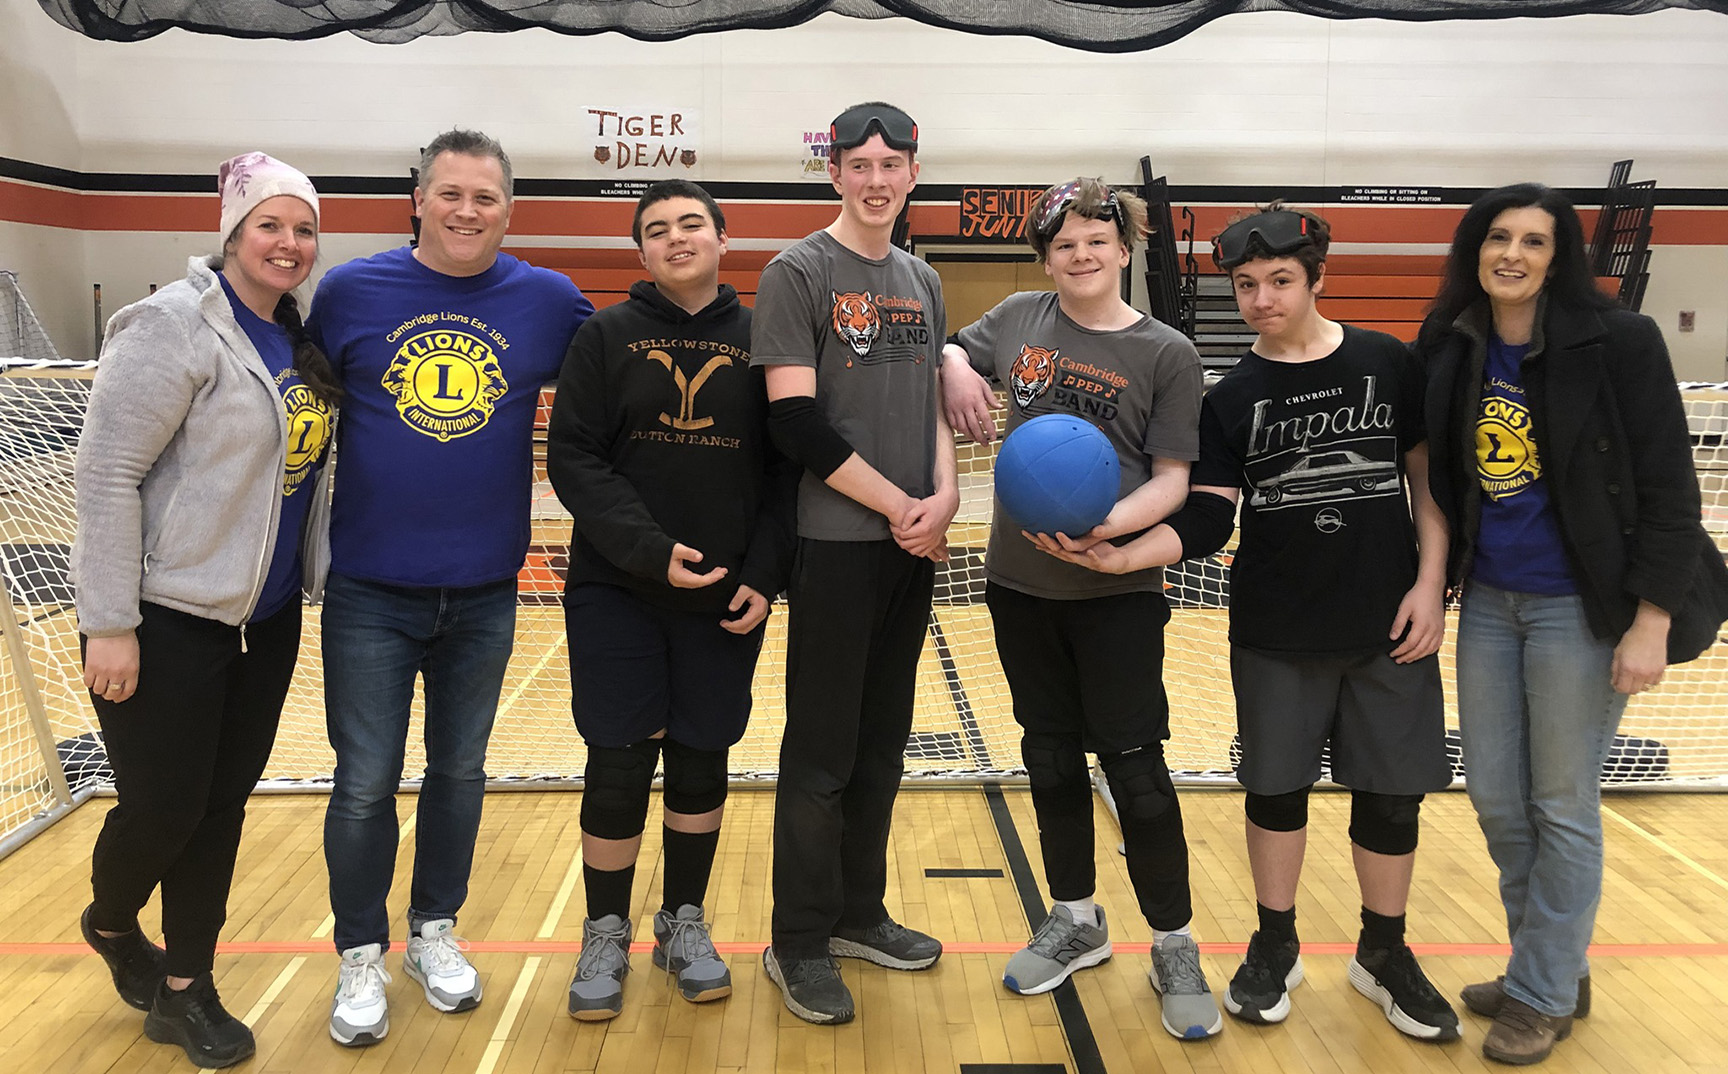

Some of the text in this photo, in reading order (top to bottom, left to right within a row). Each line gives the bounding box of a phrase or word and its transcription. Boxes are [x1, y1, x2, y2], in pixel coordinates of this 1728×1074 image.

[588, 109, 684, 137] TIGER
[803, 132, 832, 143] HAV
[811, 145, 831, 157] TH
[616, 141, 678, 169] DEN
[962, 214, 1028, 239] JUNI
[386, 311, 510, 351] Cambridge Lions Est. 1934
[891, 313, 913, 324] PEP
[411, 333, 485, 361] LIONS
[627, 338, 750, 363] YELLOWSTONE
[433, 363, 464, 400] L
[1060, 357, 1129, 388] Cambridge
[1076, 378, 1104, 394] PEP
[1051, 388, 1119, 421] BAND
[1286, 387, 1343, 405] CHEVROLET
[408, 408, 481, 432] INTERNATIONAL
[1246, 375, 1394, 457] Impala
[1484, 401, 1525, 428] ONS
